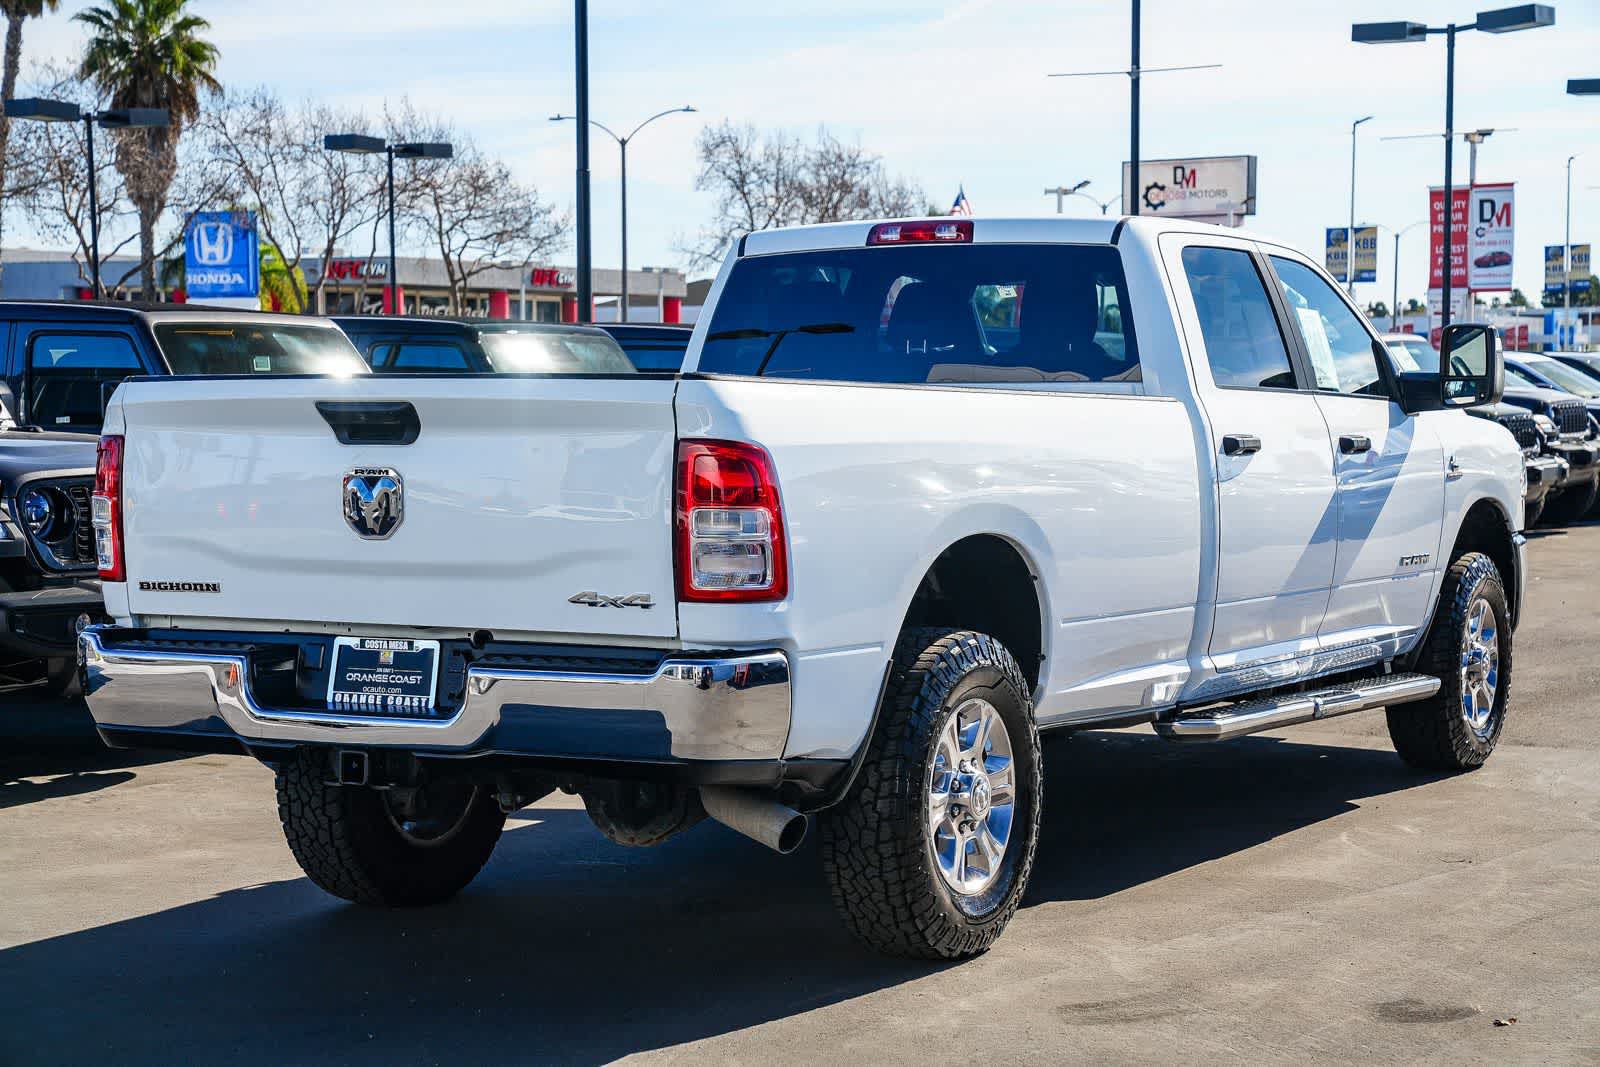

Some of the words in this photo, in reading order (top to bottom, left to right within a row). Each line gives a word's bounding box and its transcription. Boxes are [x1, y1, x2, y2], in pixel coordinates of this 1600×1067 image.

[1188, 189, 1228, 200] MOTORS
[1433, 200, 1467, 210] QULITY
[187, 272, 245, 285] HONDA
[531, 267, 560, 287] UFC
[138, 581, 220, 593] BIGHORN
[364, 639, 388, 650] COSTA
[388, 640, 409, 651] MESA
[362, 685, 402, 695] ocauto.com
[334, 692, 382, 705] ORANGE
[386, 695, 428, 708] COAST
